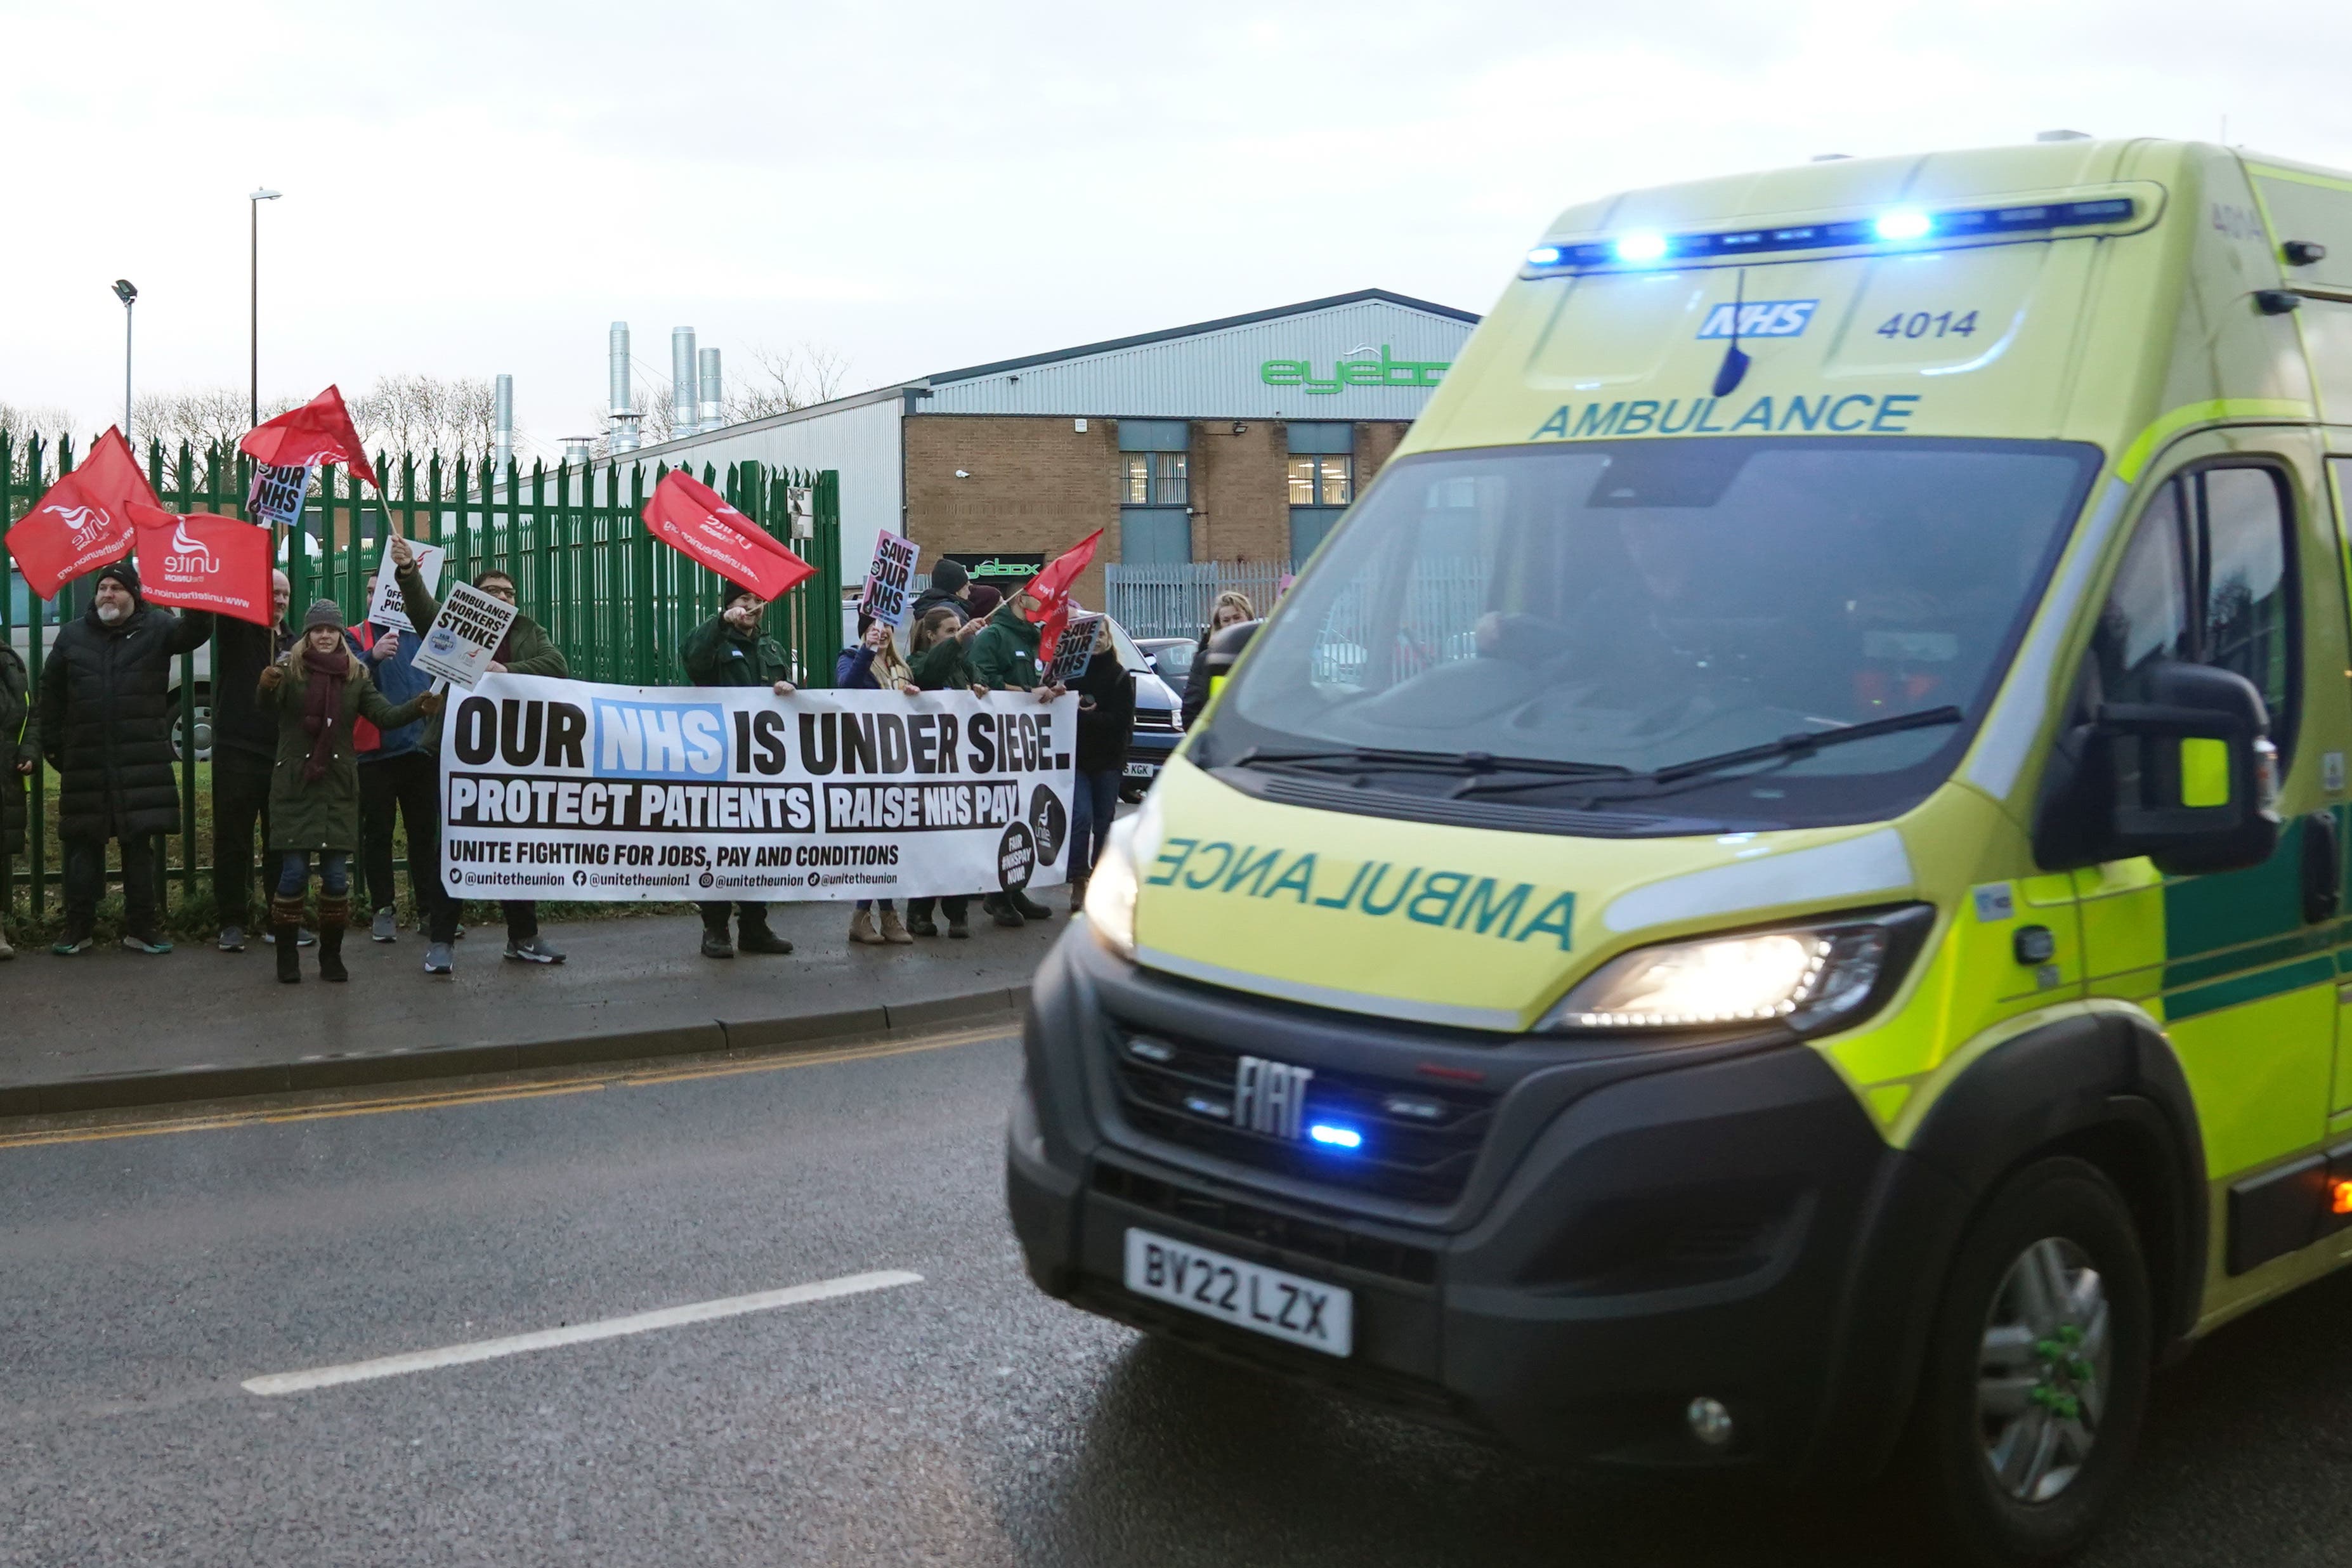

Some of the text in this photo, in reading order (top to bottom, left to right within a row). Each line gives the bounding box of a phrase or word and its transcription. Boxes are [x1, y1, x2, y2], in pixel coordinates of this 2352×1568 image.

[1700, 301, 1814, 337] NHS
[1876, 310, 1980, 339] 4014
[1261, 344, 1453, 394] eyebo
[1530, 394, 1921, 441] AMBULANCE
[256, 480, 299, 513] NHS
[880, 539, 913, 568] SAVE
[962, 558, 1041, 579] yebox
[875, 558, 908, 592] OUR
[384, 599, 405, 613] PIC
[387, 589, 403, 599] OFF
[453, 589, 511, 622] AMBULANCE
[869, 581, 903, 615] NHS
[438, 612, 499, 650] STRIKE
[447, 599, 506, 632] WORKERS'
[1062, 621, 1098, 639] SAVE
[1051, 653, 1087, 676] NHS
[454, 696, 1070, 775] OUR NHS IS UNDER SIEGE.
[1131, 764, 1148, 774] KGK
[450, 777, 1017, 828] PROTECT PATIENTS RAISE NHS PAY
[449, 839, 899, 871] UNITE FIGHTING FOR JOBS, PAY AND CONDITIONS
[464, 870, 898, 888] @unitetheunion @unitetheunion1 @unitetheunion @unitetheunion
[1235, 1055, 1315, 1140] FIAT
[1146, 1243, 1328, 1340] BV22 LZX
